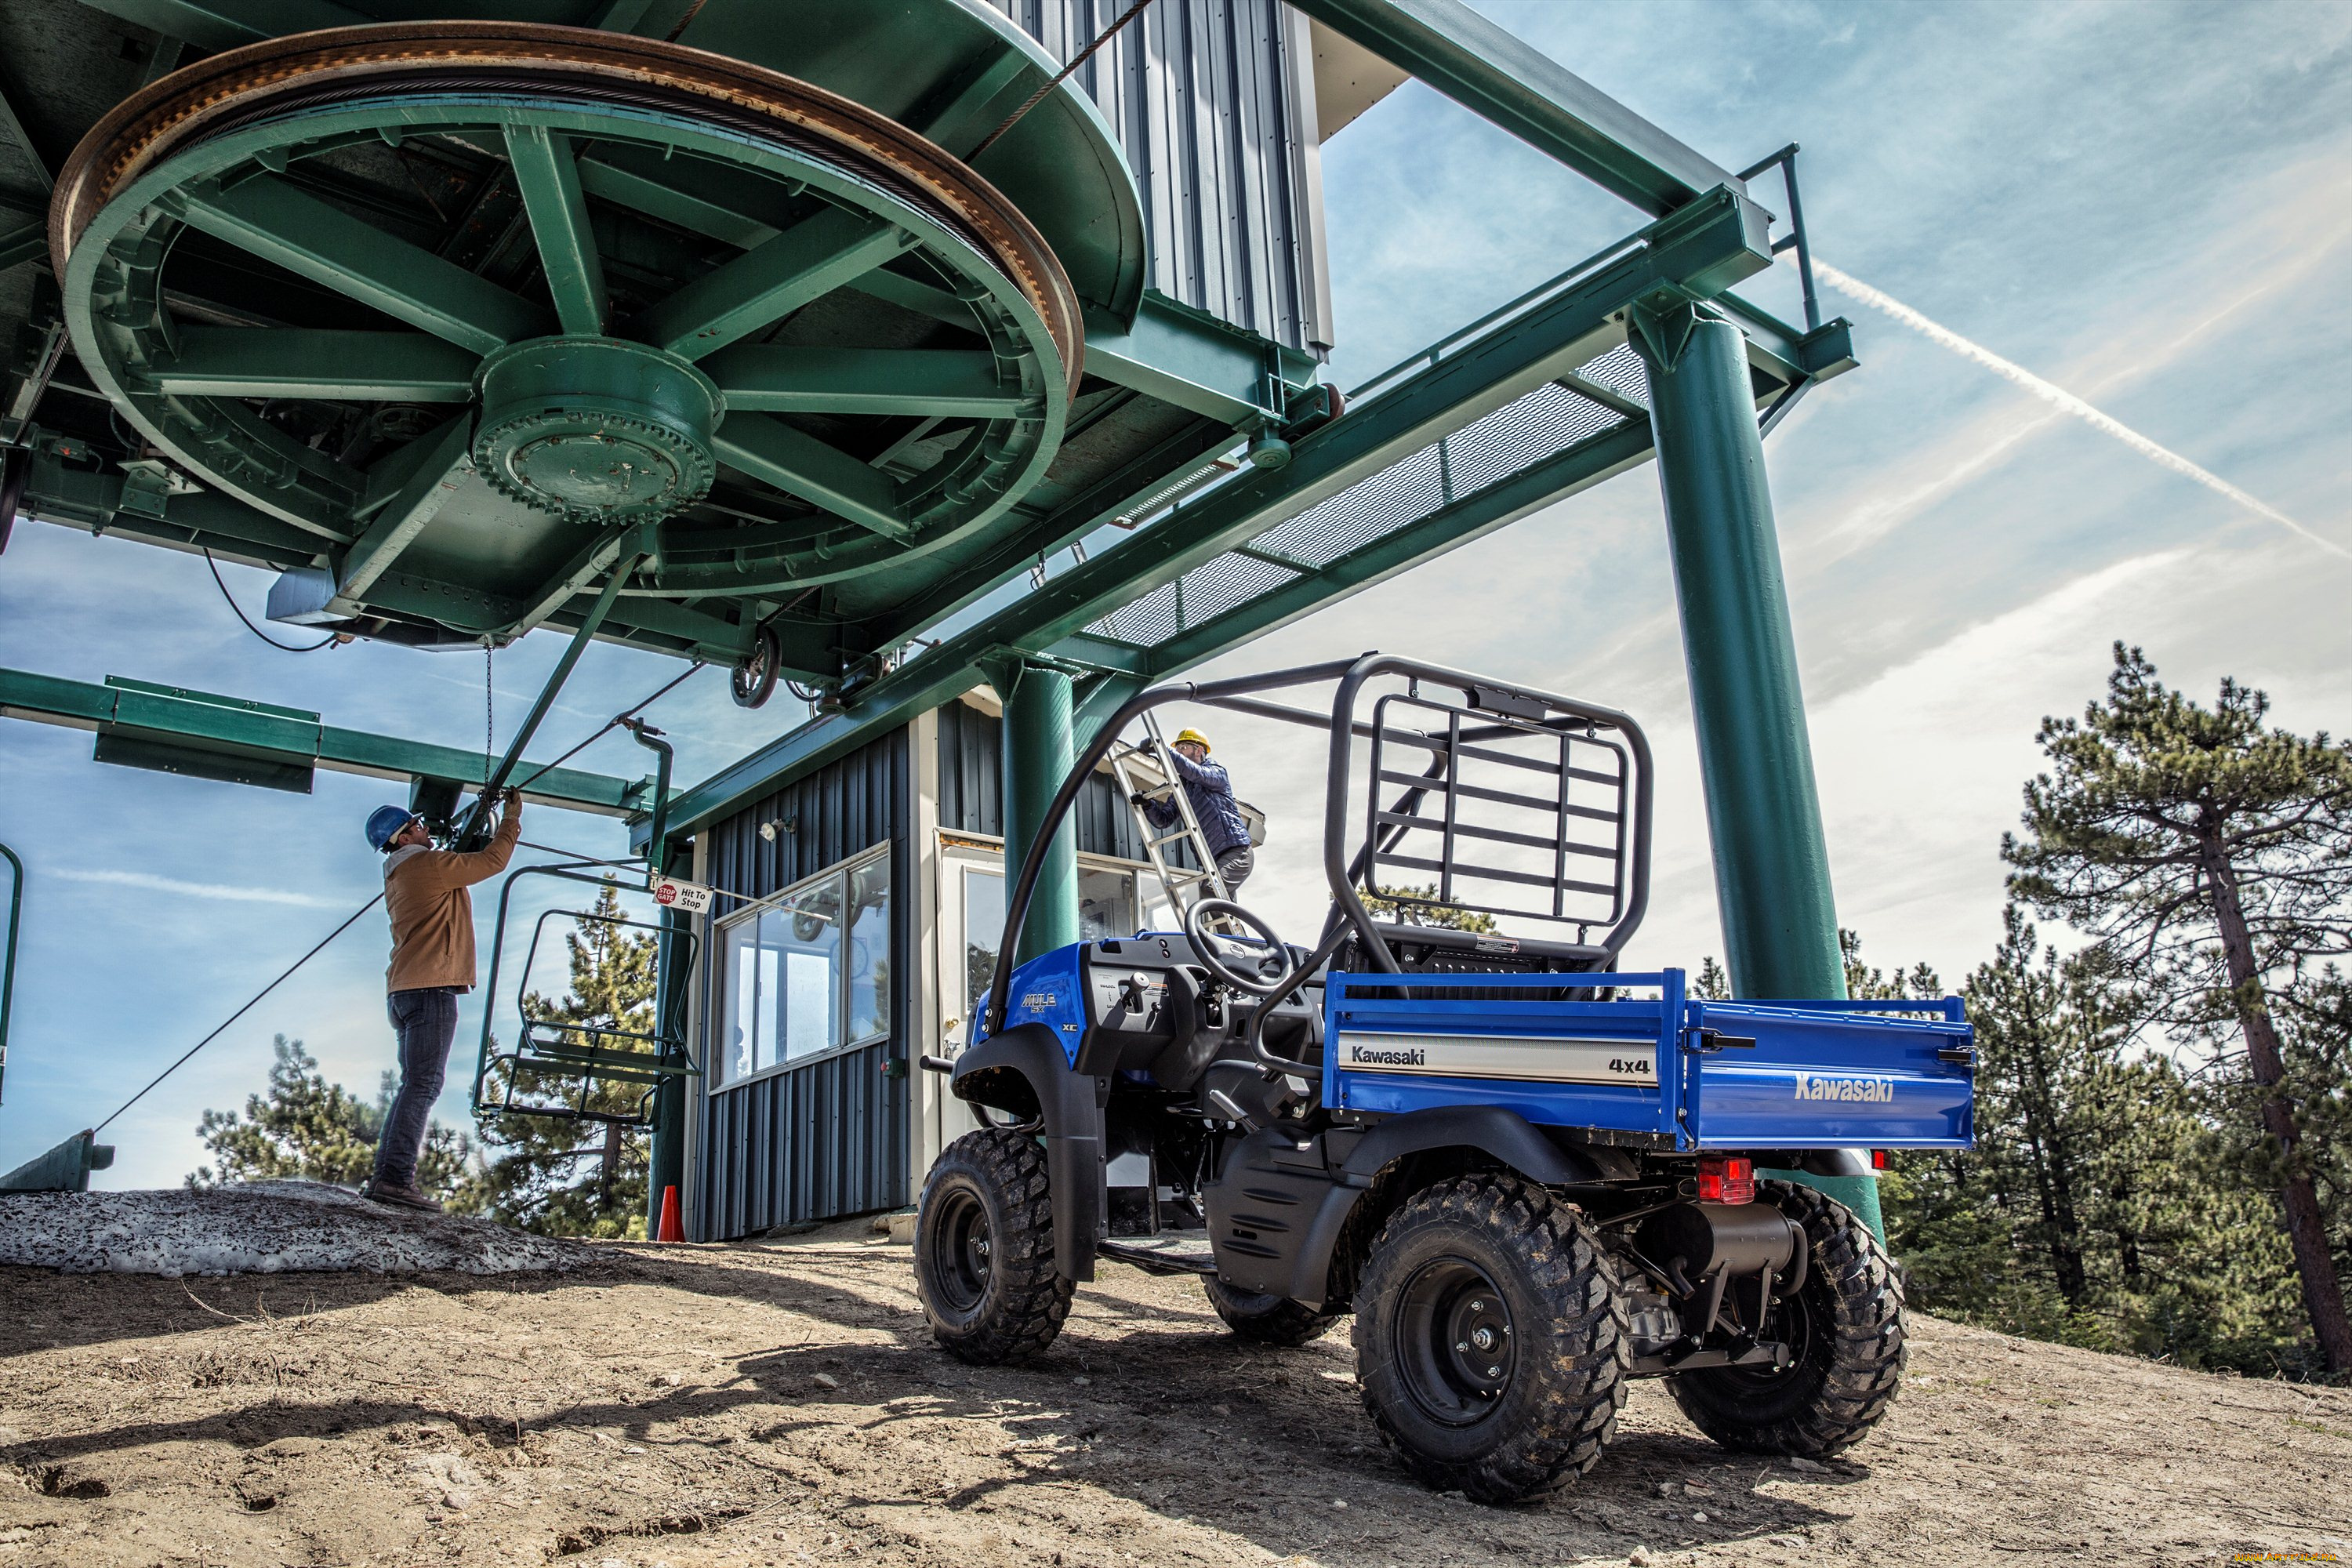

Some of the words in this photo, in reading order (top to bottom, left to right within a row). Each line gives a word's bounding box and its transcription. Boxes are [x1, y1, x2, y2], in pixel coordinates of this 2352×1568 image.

[681, 888, 694, 898] Hit
[681, 898, 700, 909] Stop
[1022, 993, 1056, 1007] MULE
[1062, 1023, 1078, 1032] XC
[1352, 1046, 1425, 1065] Kawasaki
[1609, 1058, 1651, 1074] 4x4
[1795, 1071, 1893, 1102] Kawasaki
